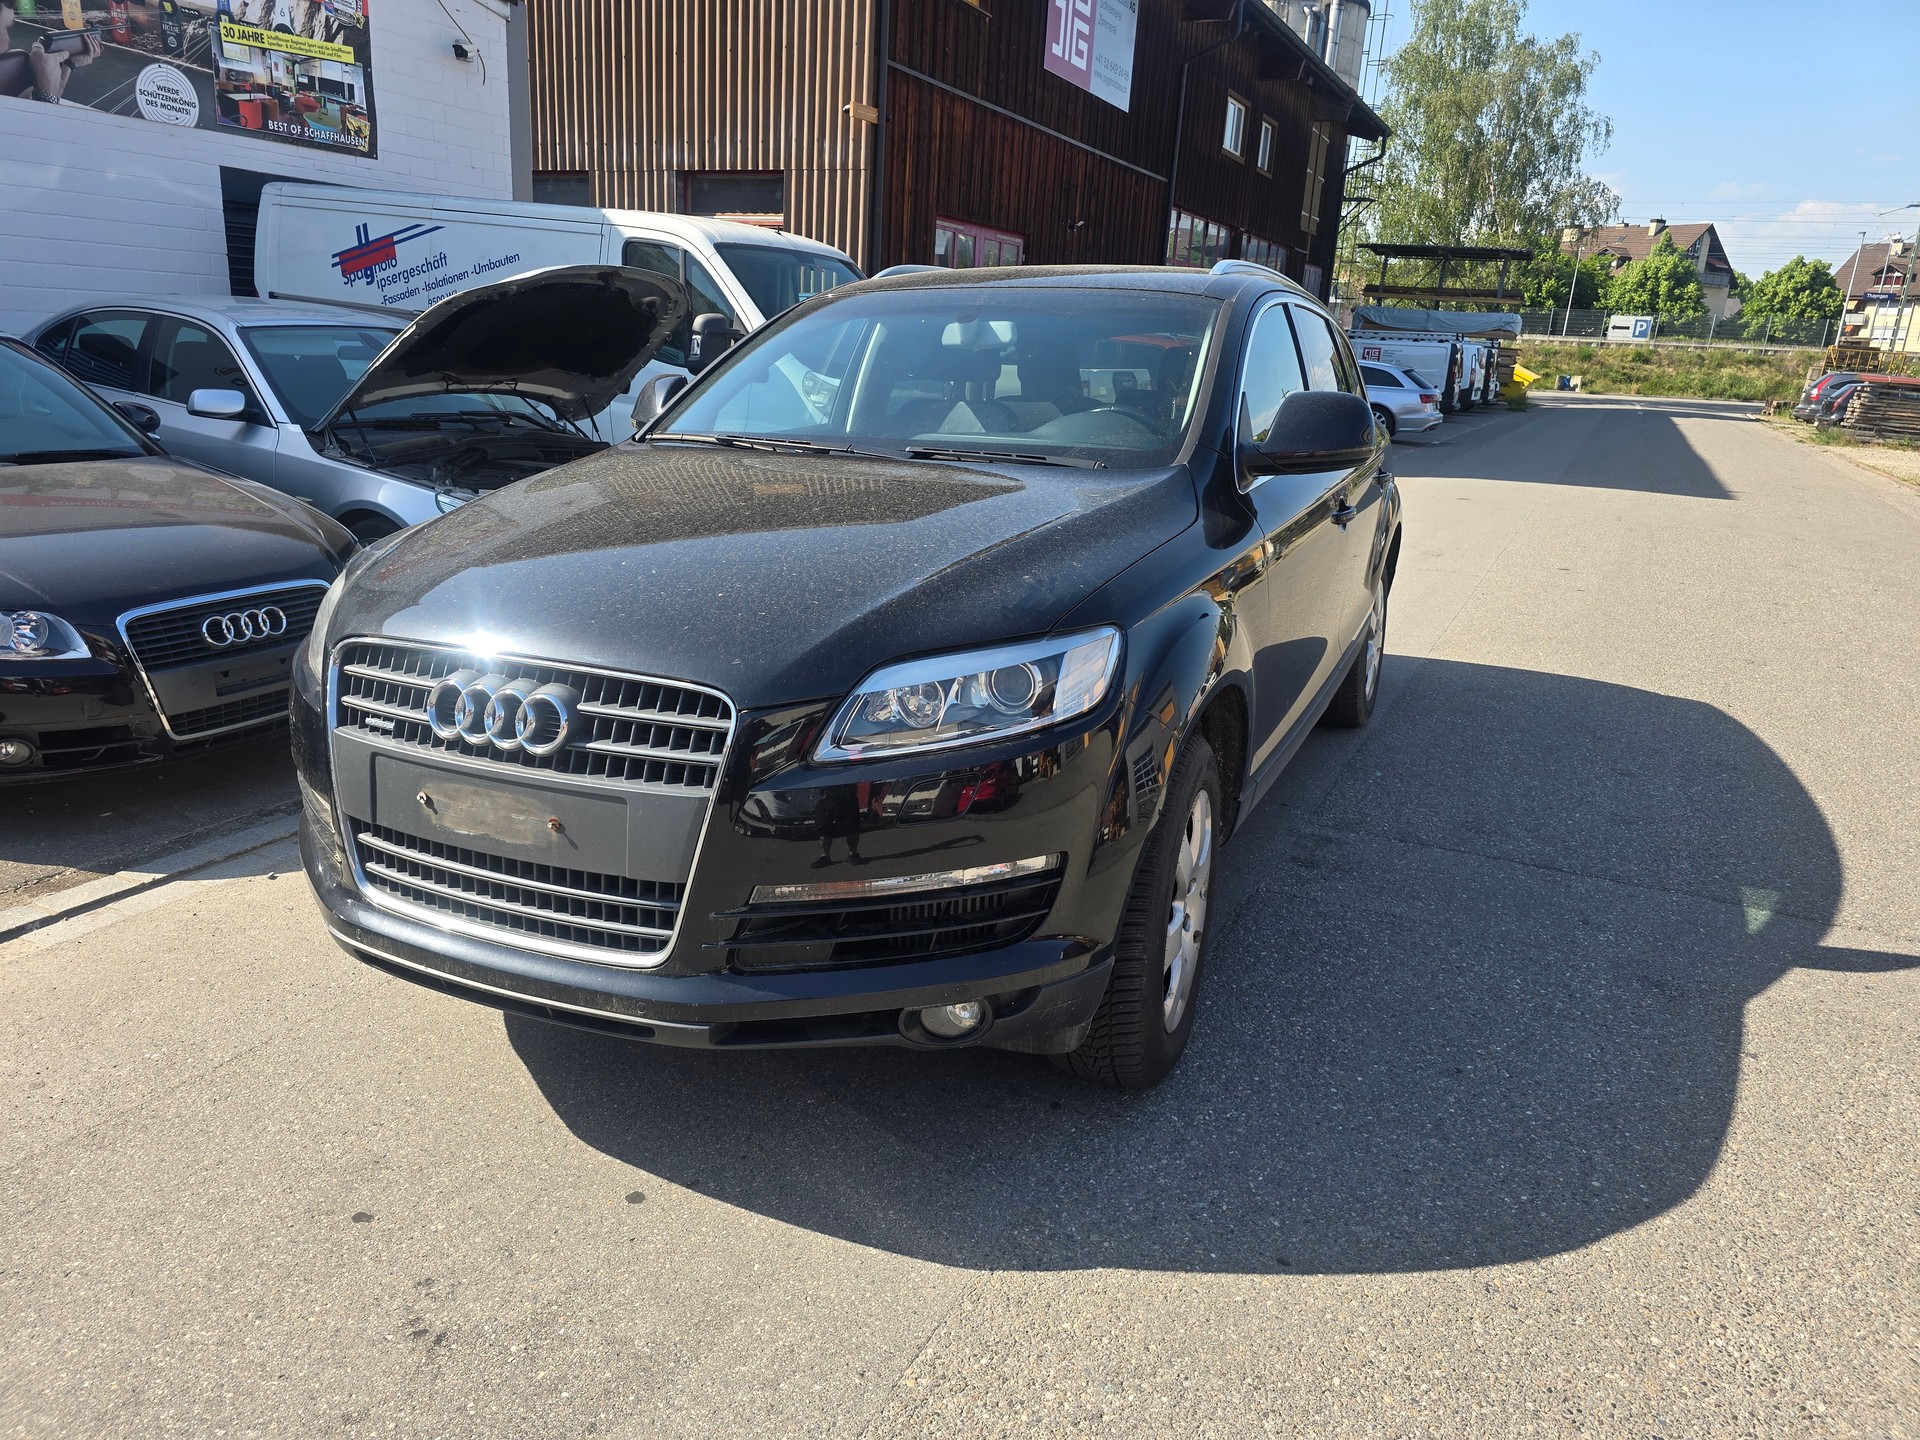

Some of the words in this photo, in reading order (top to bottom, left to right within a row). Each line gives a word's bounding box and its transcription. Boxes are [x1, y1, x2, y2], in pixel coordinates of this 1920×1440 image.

[222, 26, 235, 39] 30
[236, 29, 265, 44] JAHRE
[138, 88, 197, 109] SCHÜTZENKÖNIG
[156, 84, 180, 96] WERDE
[145, 98, 159, 108] DES
[160, 102, 191, 116] MONATS!
[268, 120, 287, 133] BEST
[290, 124, 302, 134] OF
[304, 127, 365, 147] SCHAFFHAUSEN
[381, 286, 421, 307] -Fassaden
[422, 269, 470, 292] -Isolationen
[470, 252, 521, 275] -Umbauten
[1634, 321, 1647, 336] P
